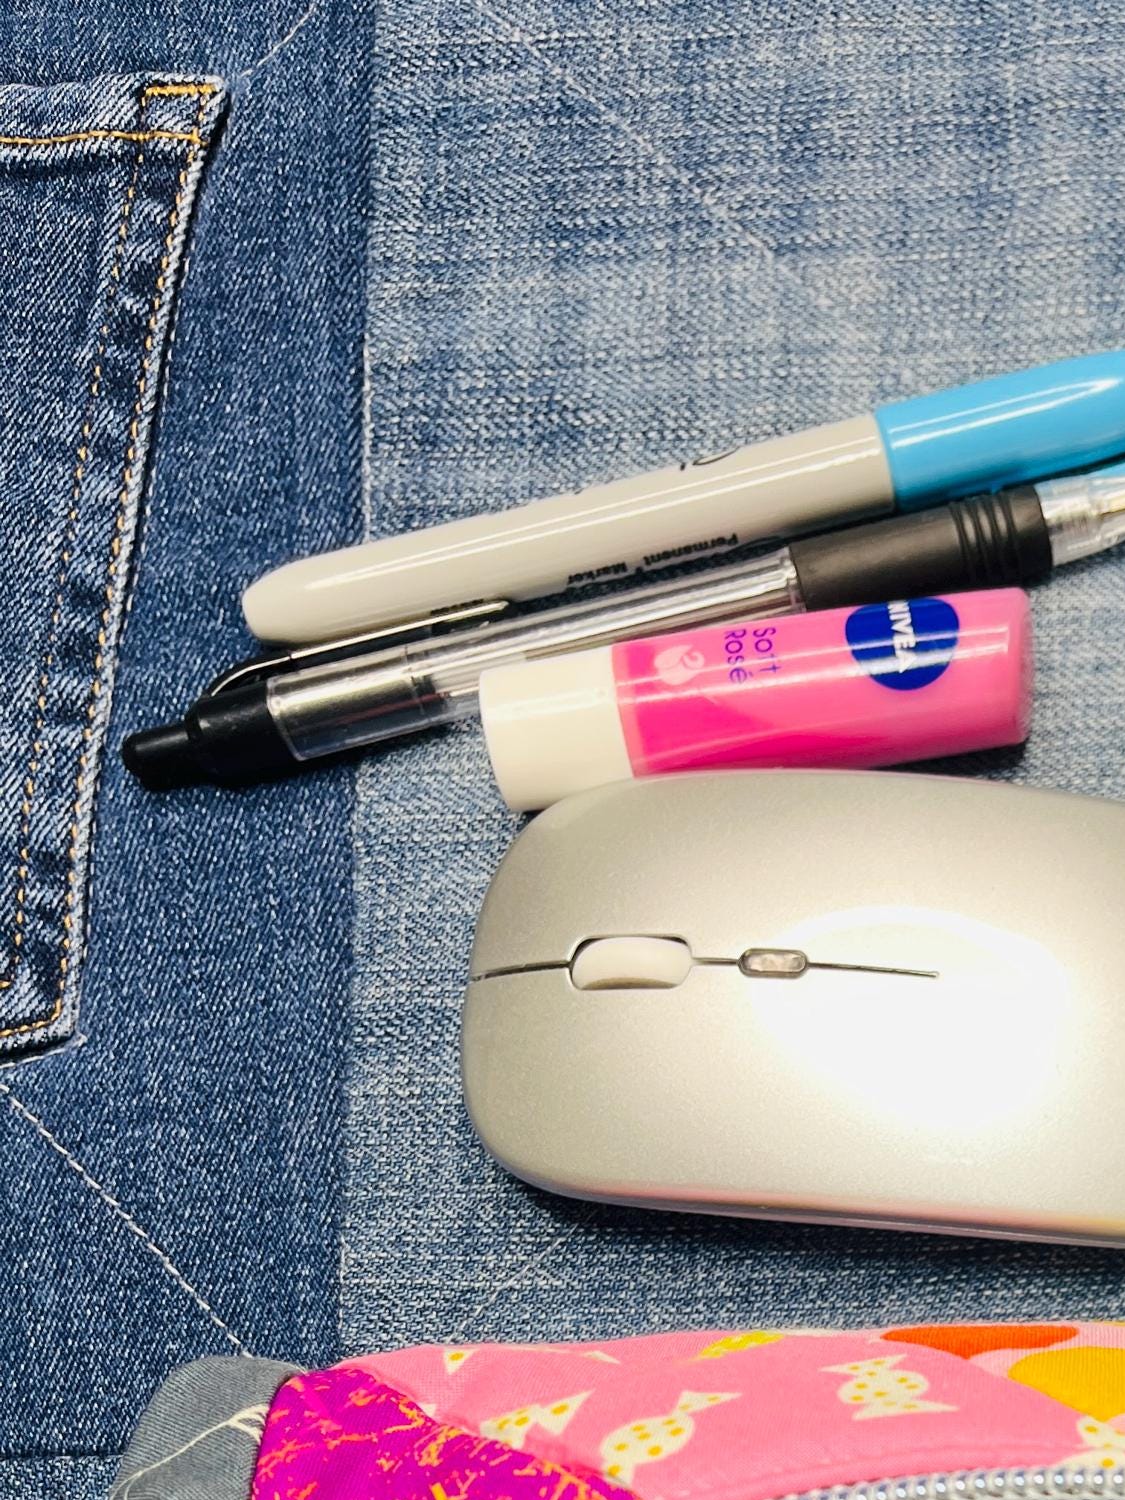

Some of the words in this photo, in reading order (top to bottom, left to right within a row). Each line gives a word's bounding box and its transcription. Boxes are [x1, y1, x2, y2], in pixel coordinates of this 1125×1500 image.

[642, 532, 739, 567] Permanent
[567, 561, 628, 587] Marker
[886, 599, 917, 674] NIVEA
